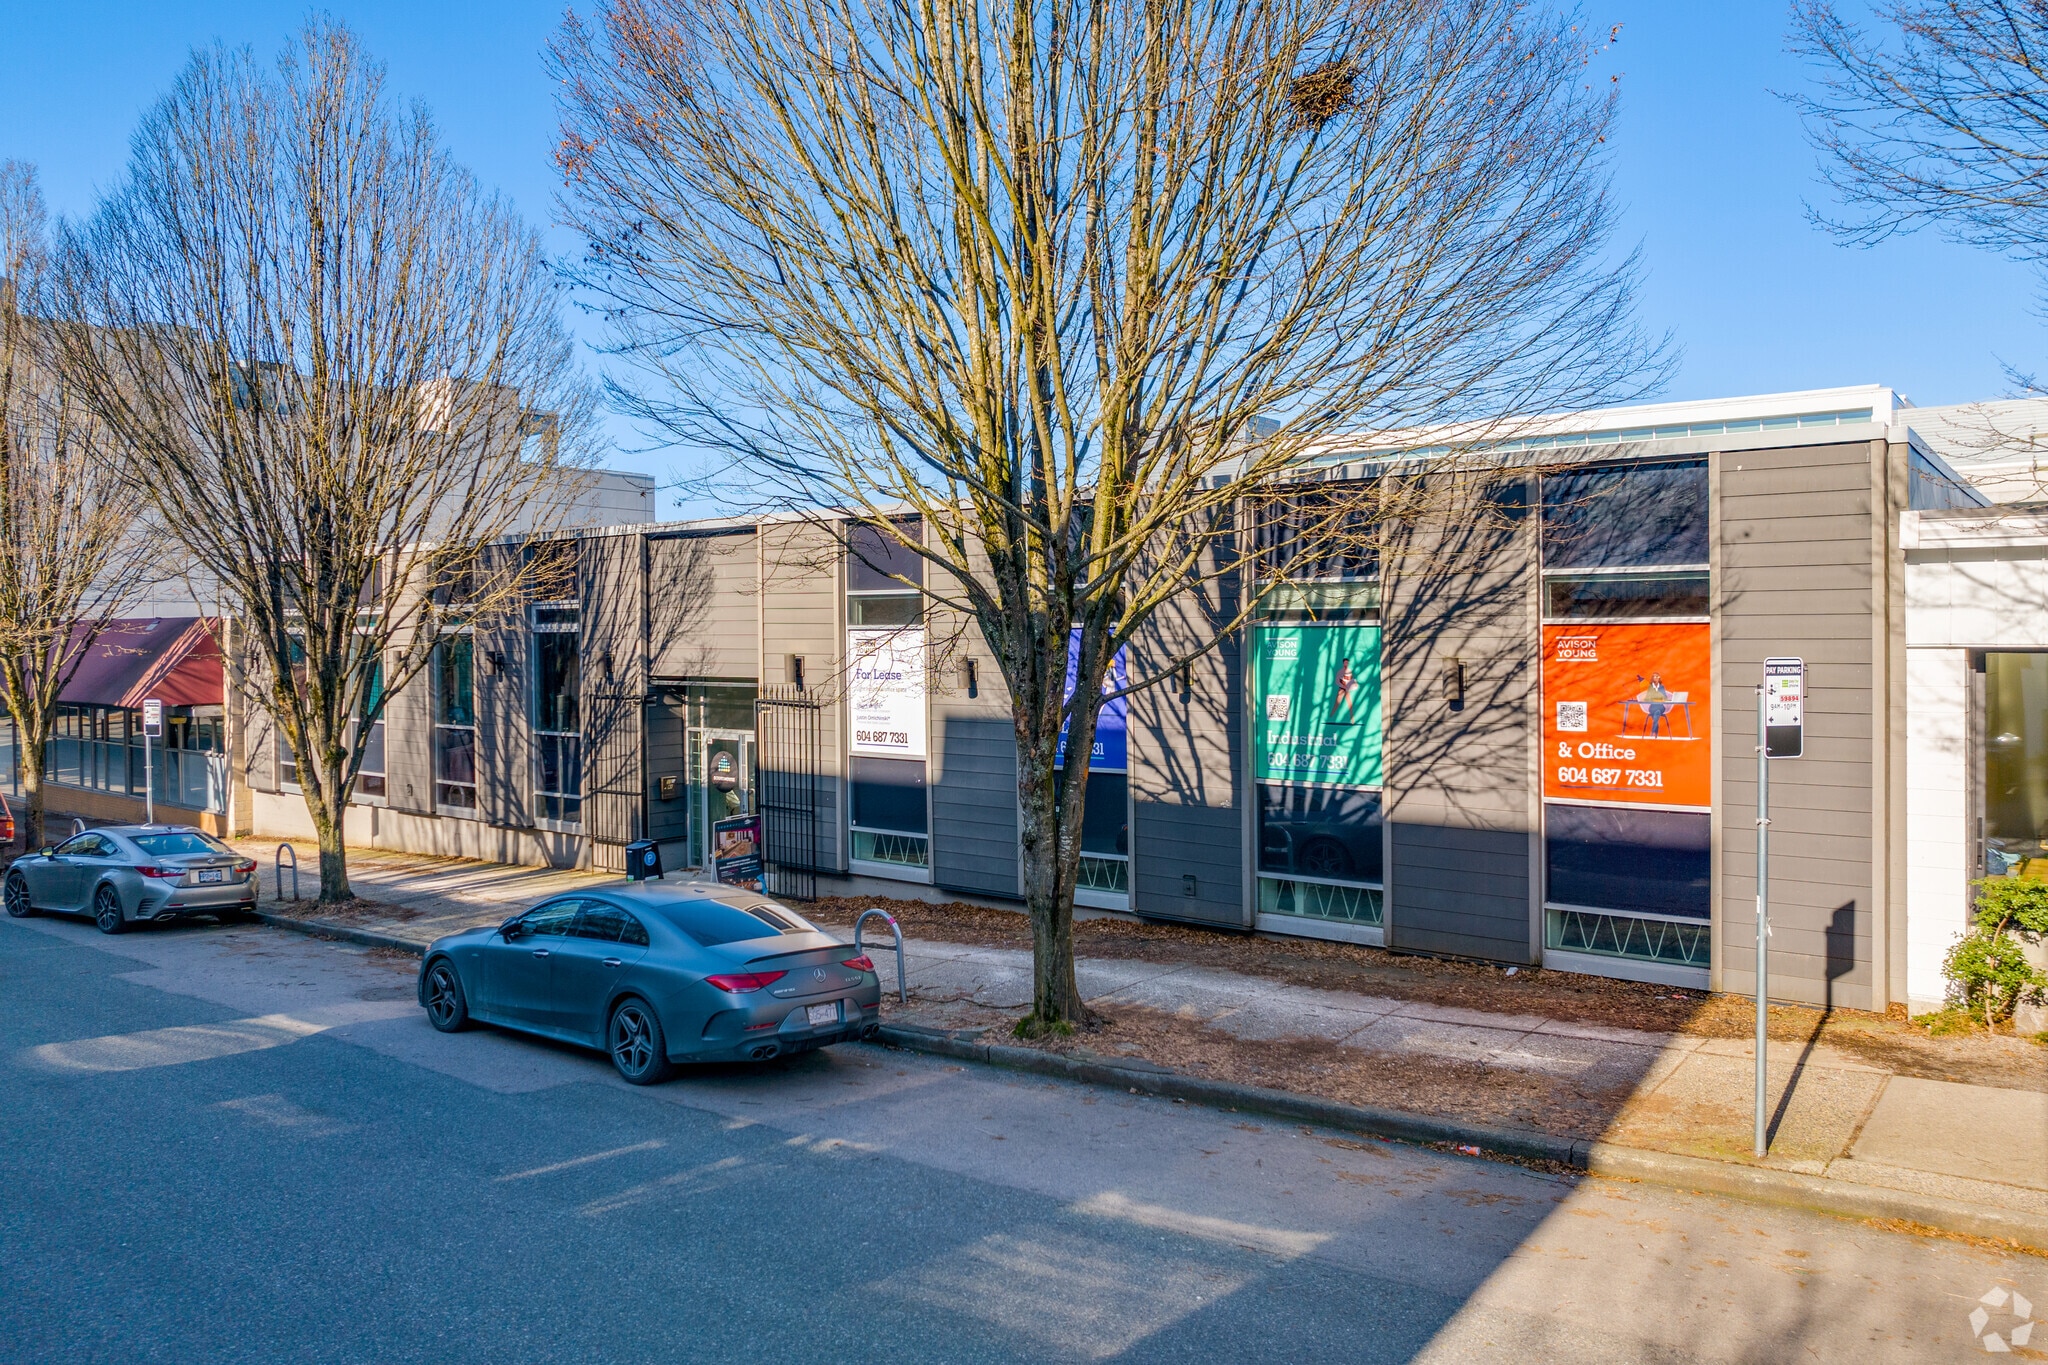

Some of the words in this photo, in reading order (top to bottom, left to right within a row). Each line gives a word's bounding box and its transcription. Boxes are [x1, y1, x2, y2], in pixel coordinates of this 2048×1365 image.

[1557, 640, 1596, 648] AVISON
[1558, 650, 1596, 658] YOUNG
[856, 668, 871, 680] For
[874, 668, 902, 680] Lease
[856, 730, 871, 741] 604
[873, 731, 888, 742] 687
[890, 732, 908, 744] 7331
[1267, 730, 1337, 746] Industrial
[1558, 742, 1572, 758] &
[1578, 742, 1636, 760] Office
[1268, 752, 1290, 766] 604
[1293, 753, 1316, 768] 687
[1320, 755, 1348, 769] 7331
[1558, 766, 1588, 783] 604
[1591, 768, 1621, 784] 687
[1625, 769, 1663, 787] 7331
